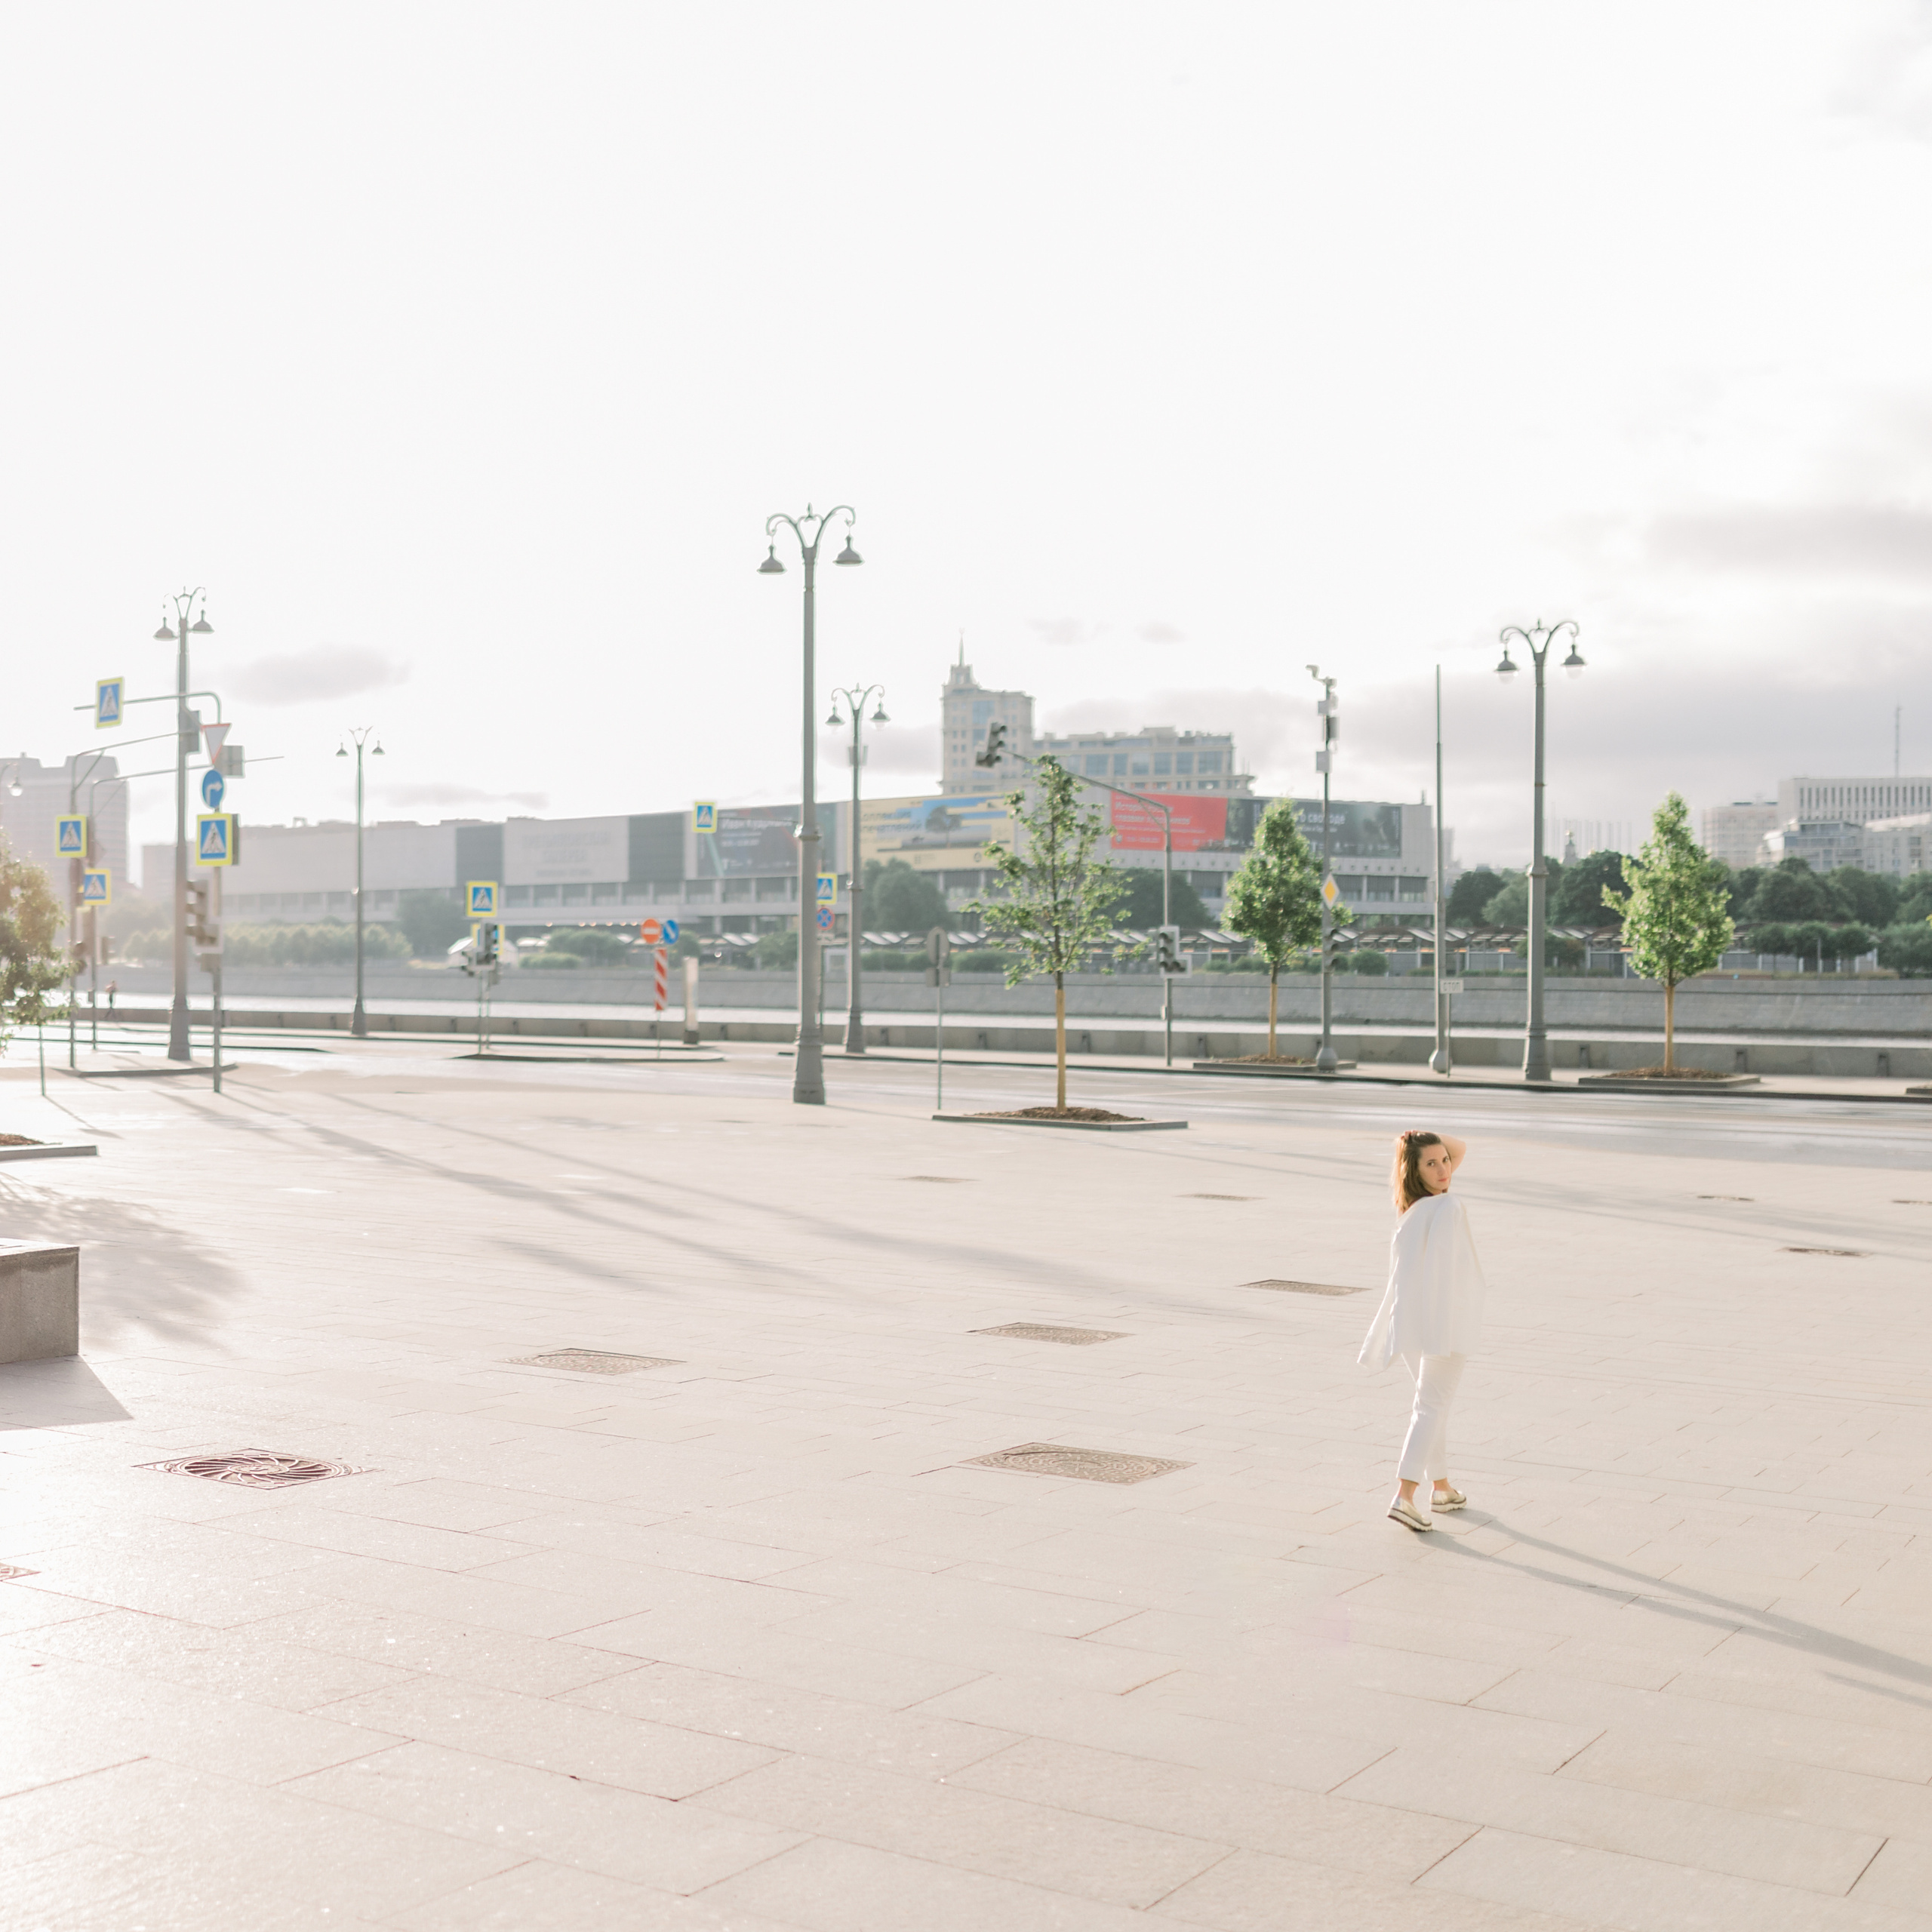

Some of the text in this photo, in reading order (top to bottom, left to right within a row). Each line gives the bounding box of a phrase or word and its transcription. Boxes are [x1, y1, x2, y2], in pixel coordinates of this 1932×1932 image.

[863, 811, 911, 821] оллекция
[1308, 814, 1345, 825] свооде
[863, 820, 922, 833] печатлений
[1443, 981, 1460, 991] СТОП
